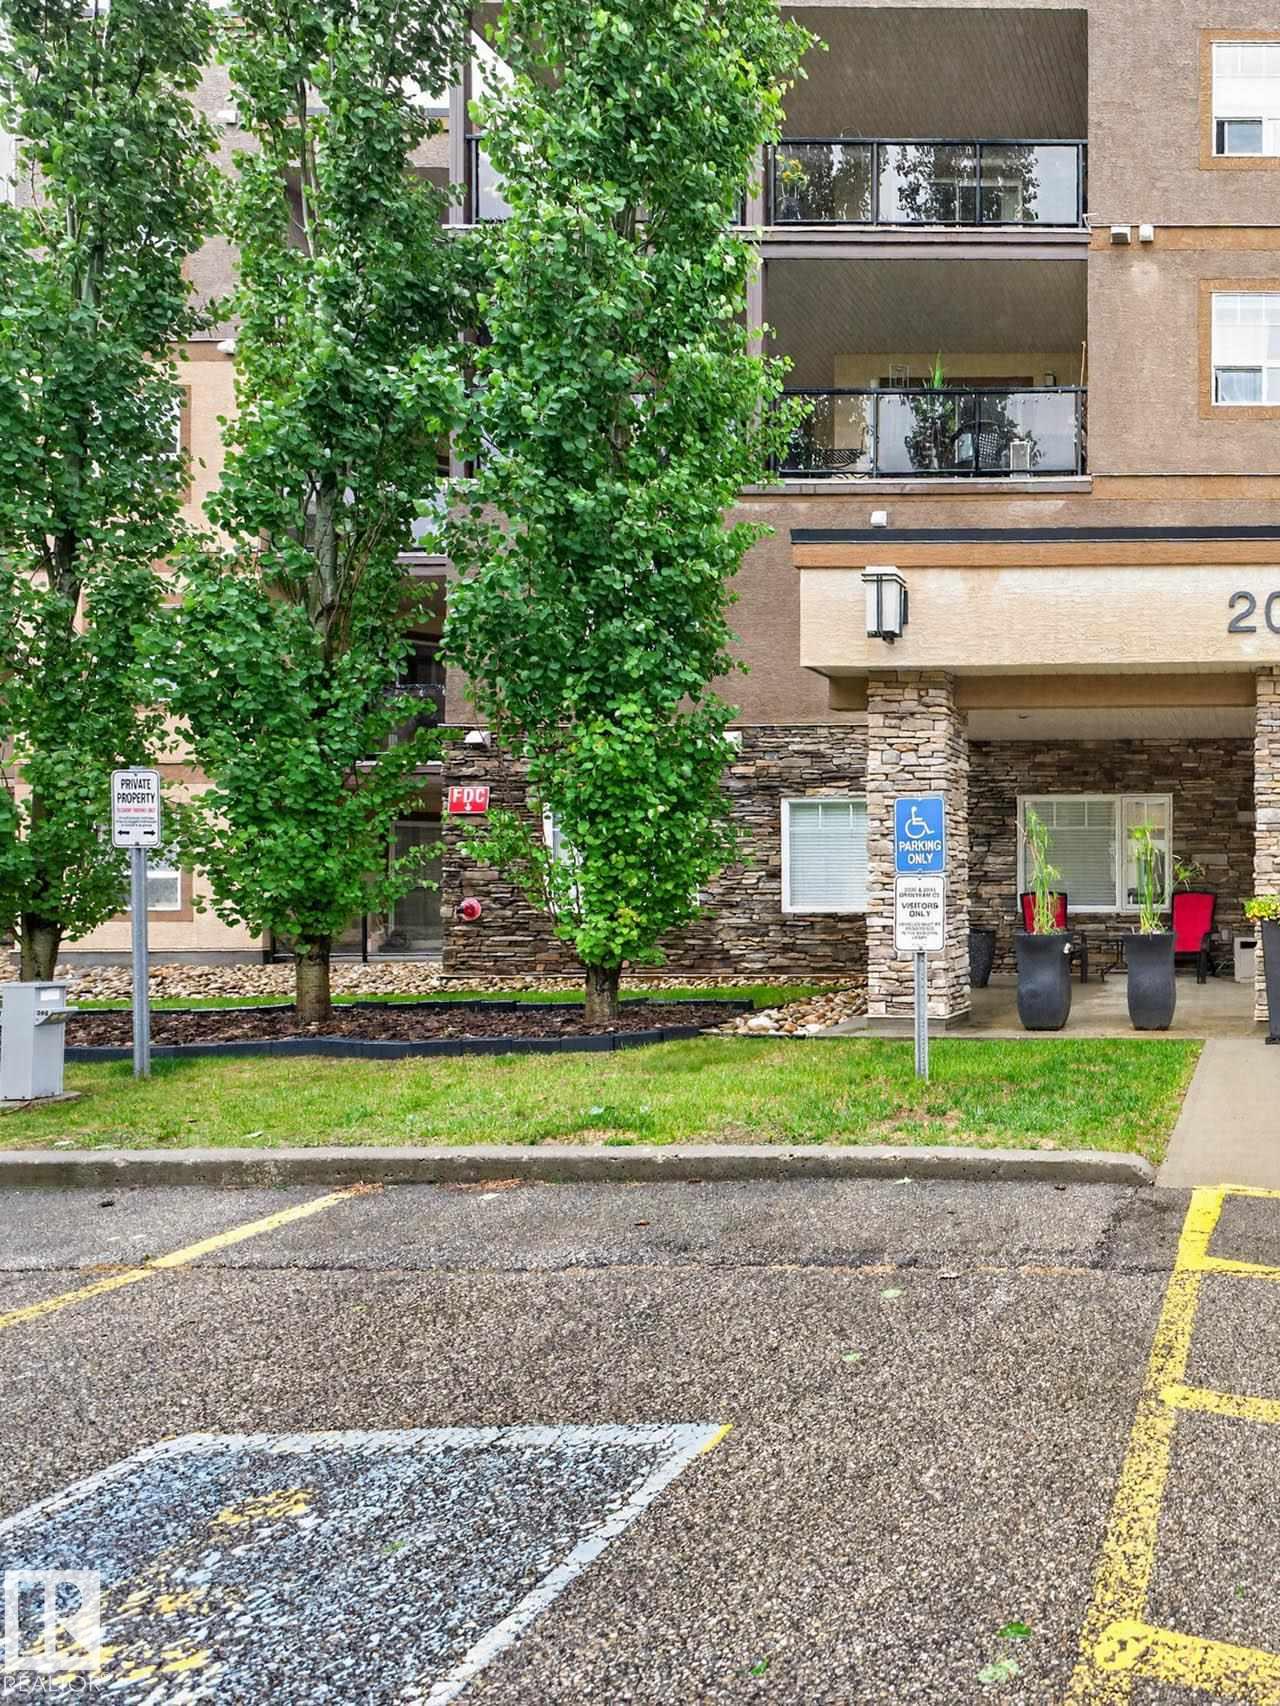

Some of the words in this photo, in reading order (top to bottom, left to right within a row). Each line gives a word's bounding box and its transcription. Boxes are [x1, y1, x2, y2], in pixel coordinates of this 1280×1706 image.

[120, 778, 151, 790] PRIVATE
[117, 793, 155, 804] PROPERTY
[453, 788, 485, 803] FDC
[899, 840, 941, 852] PARKING
[907, 853, 933, 865] ONLY
[909, 910, 931, 918] ONLY
